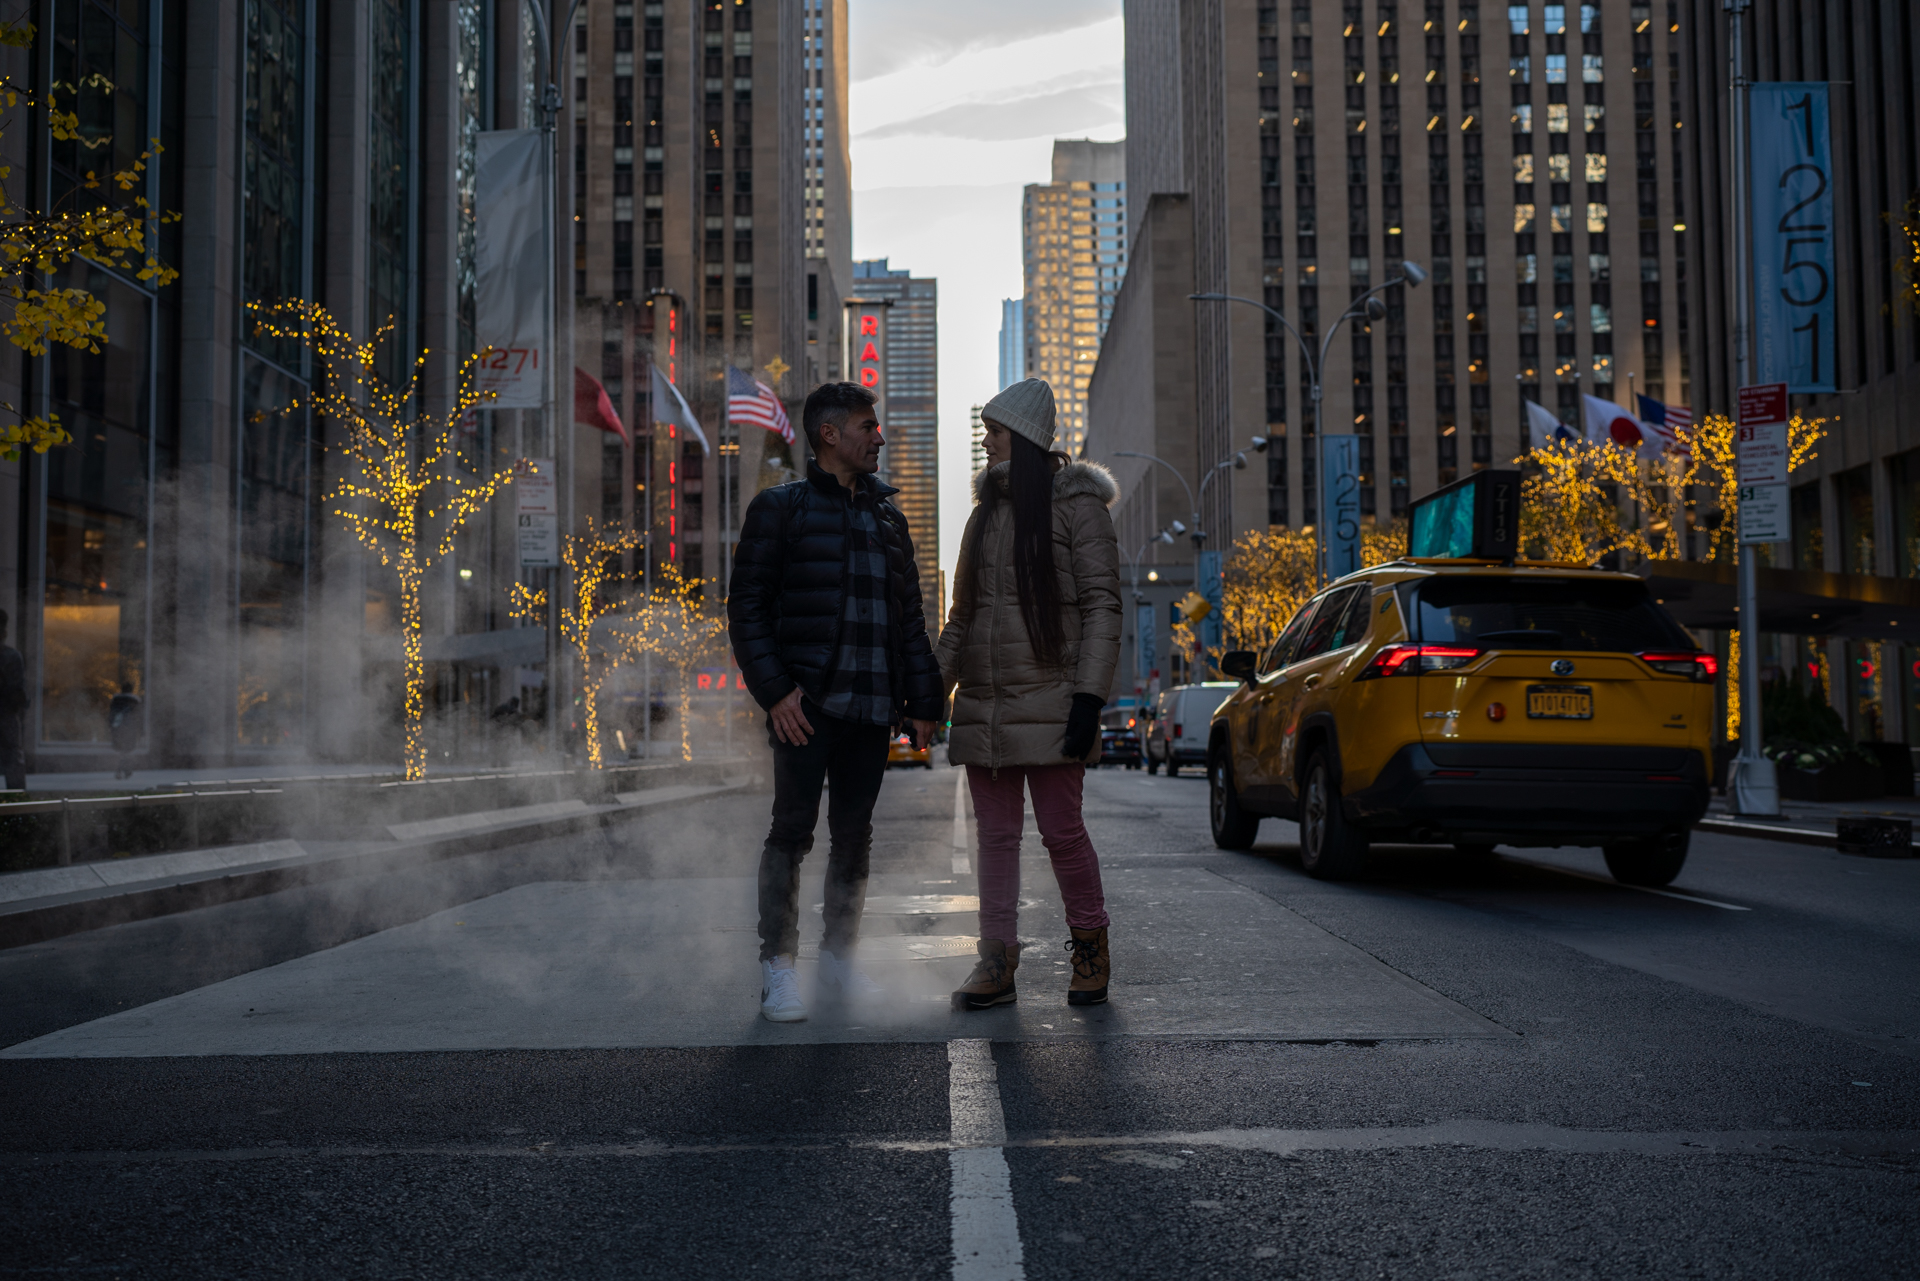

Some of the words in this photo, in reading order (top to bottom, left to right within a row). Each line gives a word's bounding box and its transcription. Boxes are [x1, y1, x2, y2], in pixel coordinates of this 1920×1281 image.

[1778, 93, 1828, 383] 1251
[481, 347, 538, 375] 1271
[860, 315, 882, 434] RAD
[1743, 428, 1751, 440] 3
[1336, 440, 1358, 573] 1251
[1495, 484, 1508, 542] 7T13
[1743, 488, 1751, 500] 5
